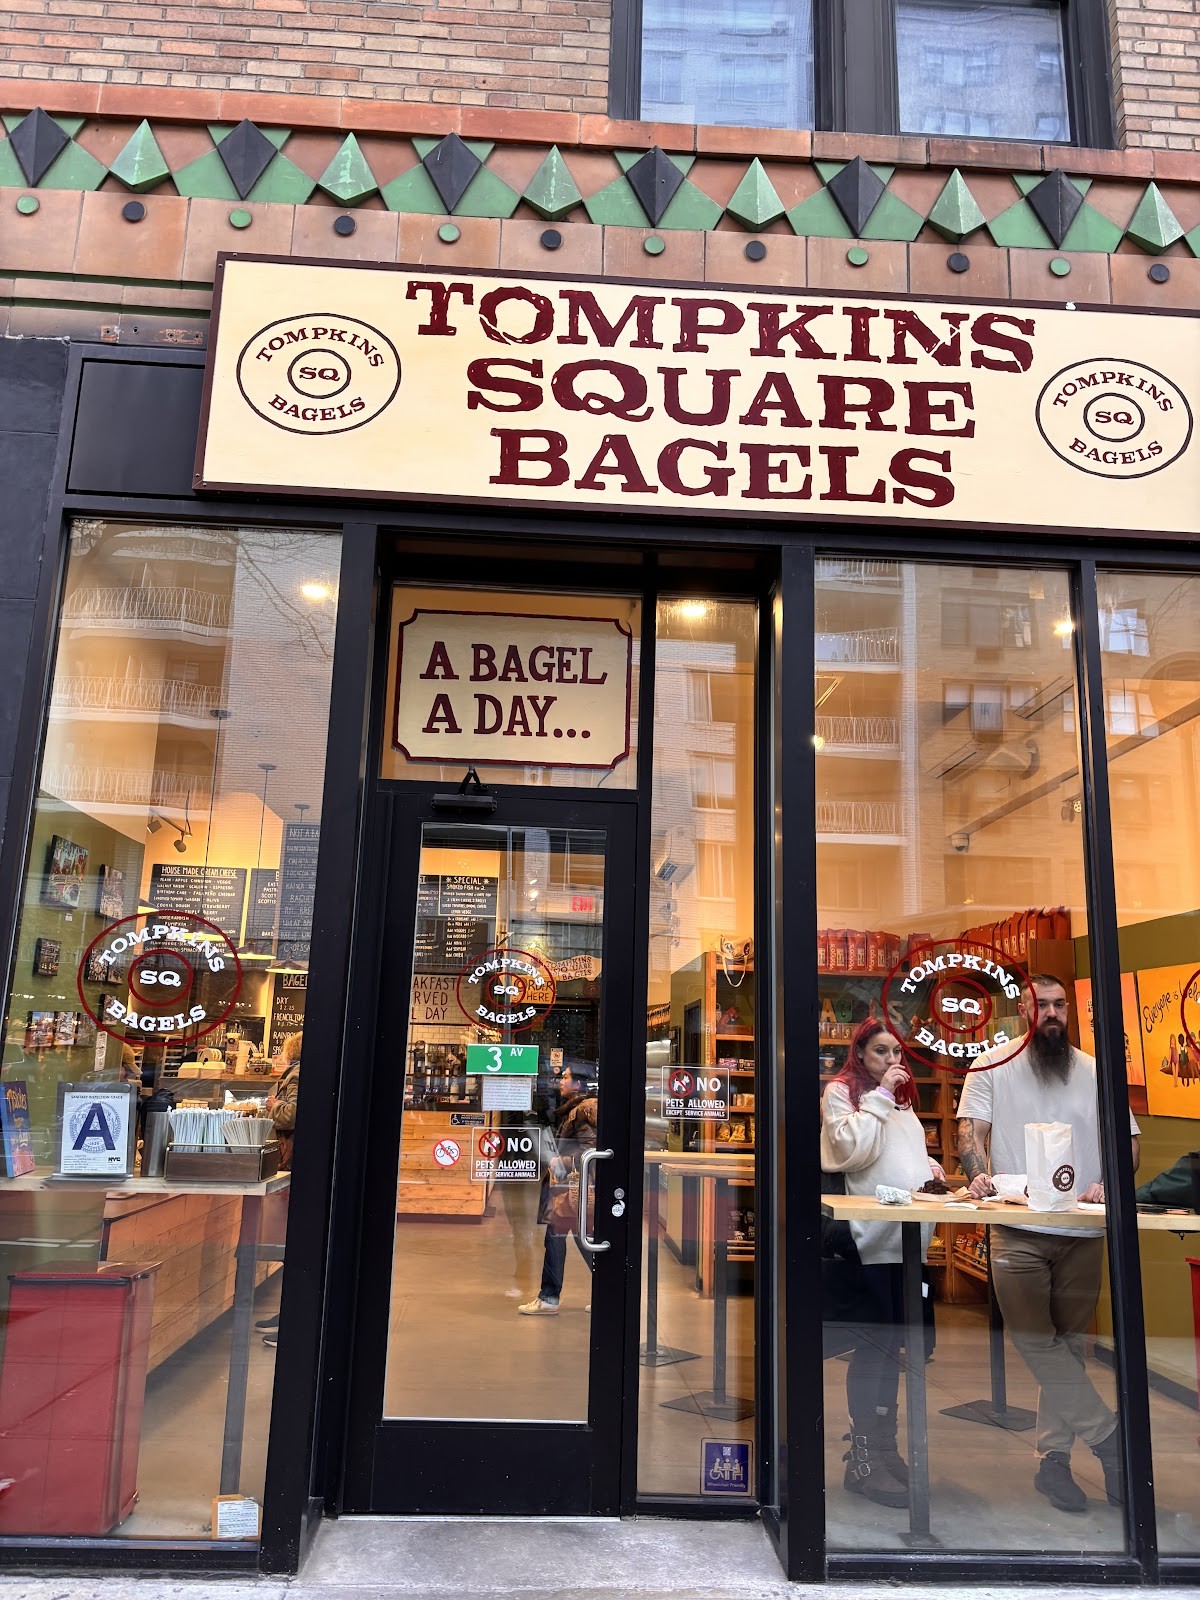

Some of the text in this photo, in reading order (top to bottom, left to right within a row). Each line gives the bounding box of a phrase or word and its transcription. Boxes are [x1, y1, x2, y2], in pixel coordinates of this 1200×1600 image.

[405, 280, 1035, 373] TOMPKINS
[256, 327, 385, 369] TOMPKINS
[299, 366, 341, 383] SQ
[467, 357, 975, 438] SQUARE
[1053, 371, 1174, 412] TOMPKINS
[268, 394, 366, 422] BAGELS
[1095, 409, 1135, 427] SQ
[1068, 438, 1164, 466] BAGELS
[488, 428, 955, 508] BAGELS
[420, 641, 608, 685] A BAGEL
[422, 694, 591, 739] A DAY...
[162, 866, 180, 874] HOUSE
[182, 867, 198, 876] MADE
[220, 868, 236, 876] CHEESE
[454, 876, 482, 885] SPECIAL
[98, 925, 225, 973] TOMPKINS
[140, 970, 182, 987] SQ
[468, 958, 545, 987] TOMPKINS
[900, 954, 1021, 1000] TOMPKINS
[276, 997, 289, 1005] DRY
[414, 991, 448, 1005] RVED
[494, 985, 519, 996] SQ
[526, 992, 550, 1002] HERE
[106, 1000, 206, 1032] BAGELS
[426, 1007, 448, 1020] DAY
[476, 1005, 537, 1024] BAGELS
[941, 998, 982, 1015] SQ
[914, 1027, 1010, 1058] BAGELS
[486, 1046, 523, 1072] 3 AV
[696, 1077, 721, 1092] NO
[666, 1098, 725, 1108] PETS ALLOWED
[72, 1103, 116, 1150] A
[507, 1138, 532, 1152] NO
[476, 1160, 536, 1169] PETS ALLOWED
